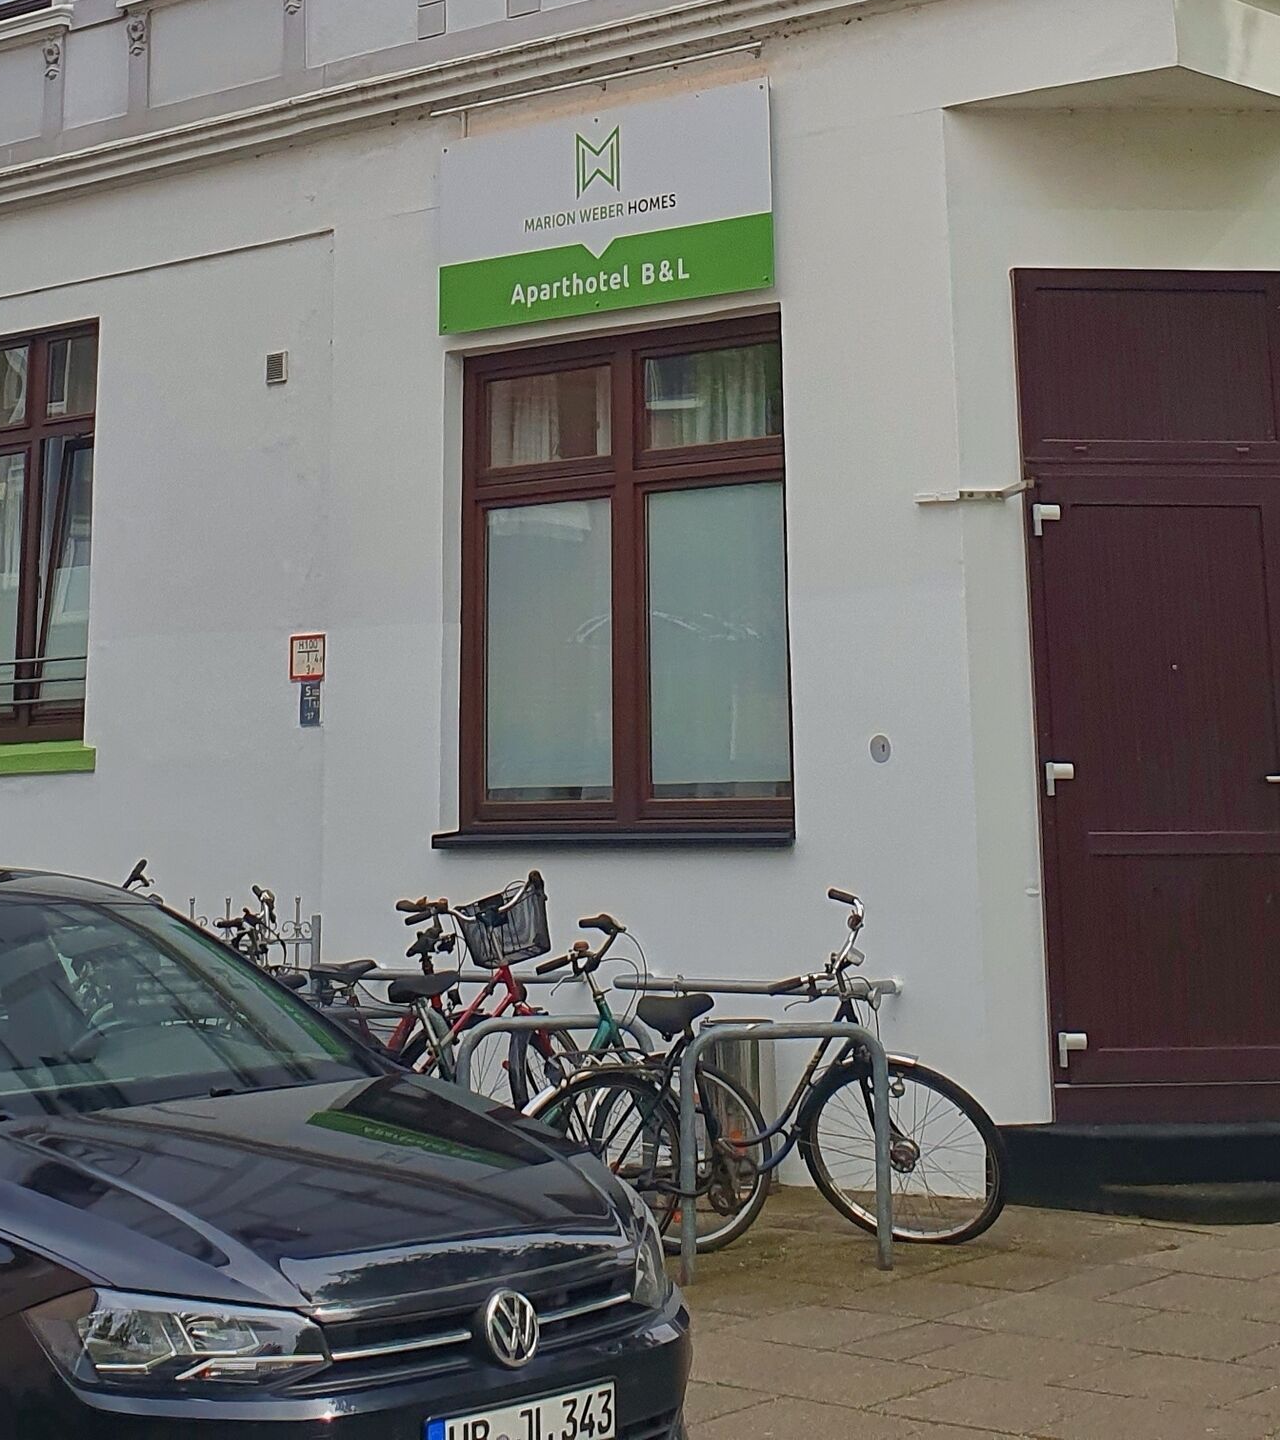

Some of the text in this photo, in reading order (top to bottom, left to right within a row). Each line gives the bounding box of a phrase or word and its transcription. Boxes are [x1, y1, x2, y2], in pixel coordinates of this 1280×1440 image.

[524, 193, 677, 233] MARION WEBER HOMES
[510, 265, 630, 308] Aparthotel
[562, 1388, 613, 1440] 343
